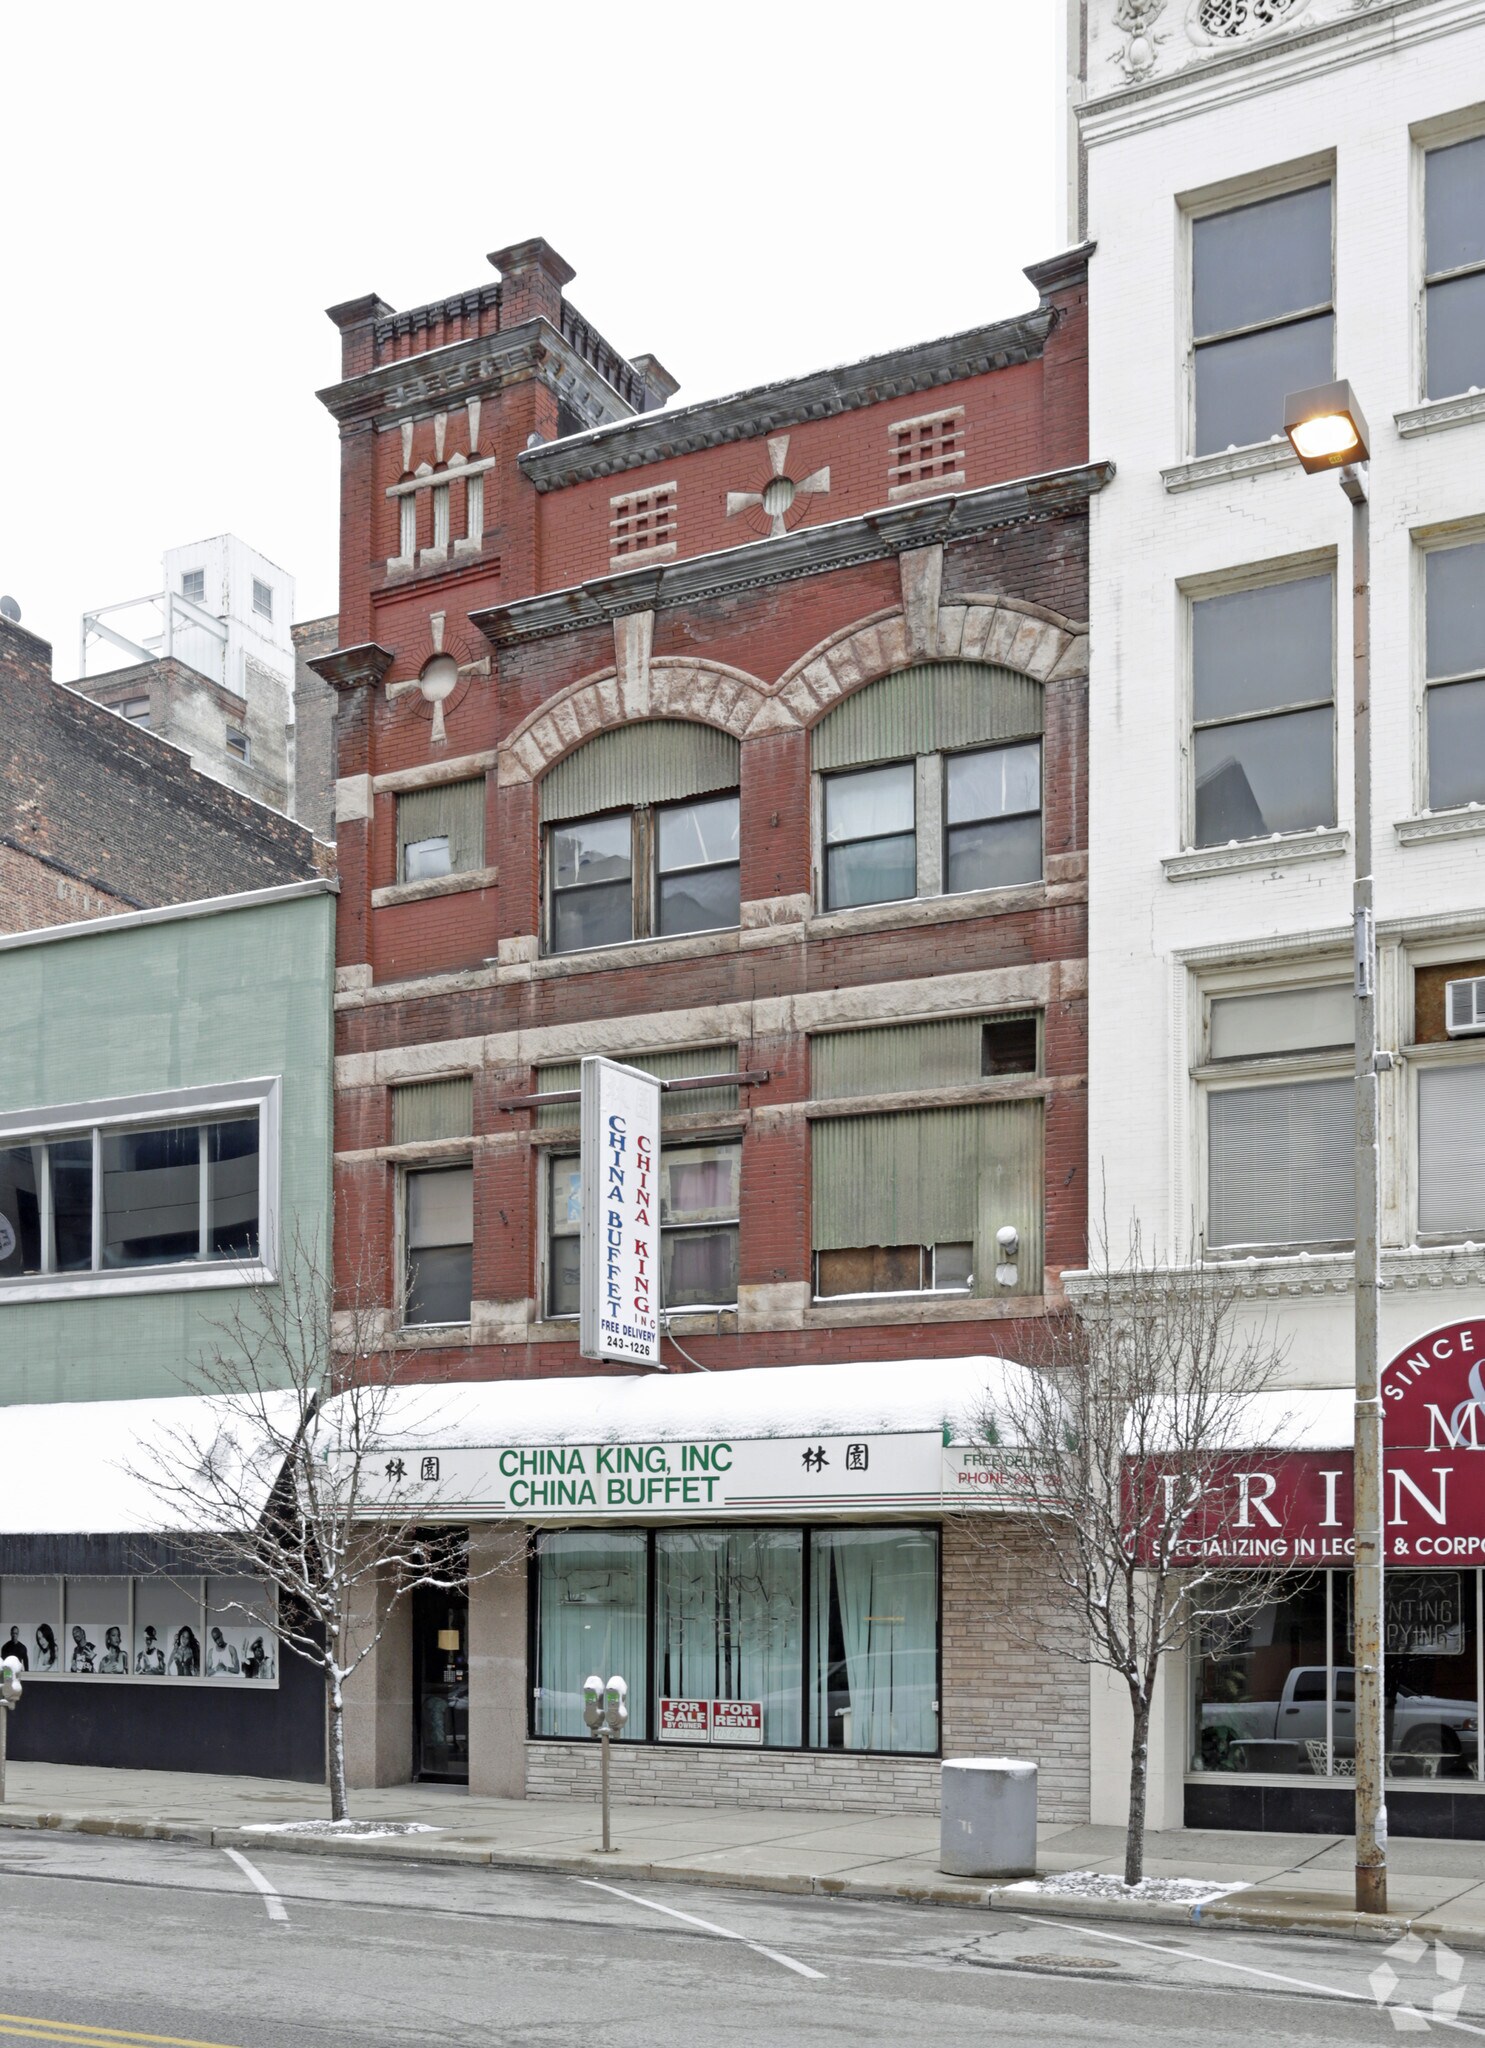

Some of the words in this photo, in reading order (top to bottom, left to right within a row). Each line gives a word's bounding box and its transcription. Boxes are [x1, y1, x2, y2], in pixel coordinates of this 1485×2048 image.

[608, 1115, 626, 1203] CHINA
[634, 1135, 651, 1227] CHINA
[607, 1210, 623, 1318] BUFFET
[633, 1239, 650, 1314] KING
[601, 1318, 620, 1334] FREE
[622, 1324, 656, 1343] DELIVERY
[634, 1313, 656, 1330] INC
[607, 1335, 650, 1356] 243-1226
[1384, 1331, 1474, 1400] SINCE
[1423, 1402, 1485, 1452] M
[499, 1448, 586, 1477] CHINA
[596, 1447, 672, 1476] KING,
[681, 1443, 733, 1472] INC
[801, 1443, 869, 1473] 林園
[963, 1454, 1001, 1467] FREE
[509, 1477, 597, 1506] CHINA
[607, 1476, 721, 1505] BUFFET
[958, 1472, 1008, 1485] PHONE
[1152, 1538, 1288, 1557] SECIALIZING
[1294, 1538, 1316, 1556] IN
[1393, 1537, 1410, 1556] &
[1415, 1536, 1485, 1555] CORP
[1387, 1600, 1452, 1623] NTING
[1387, 1623, 1448, 1648] PYING
[663, 1711, 706, 1722] SALE
[669, 1702, 700, 1712] FOR
[720, 1703, 753, 1715] FOR
[715, 1715, 759, 1727] RENT
